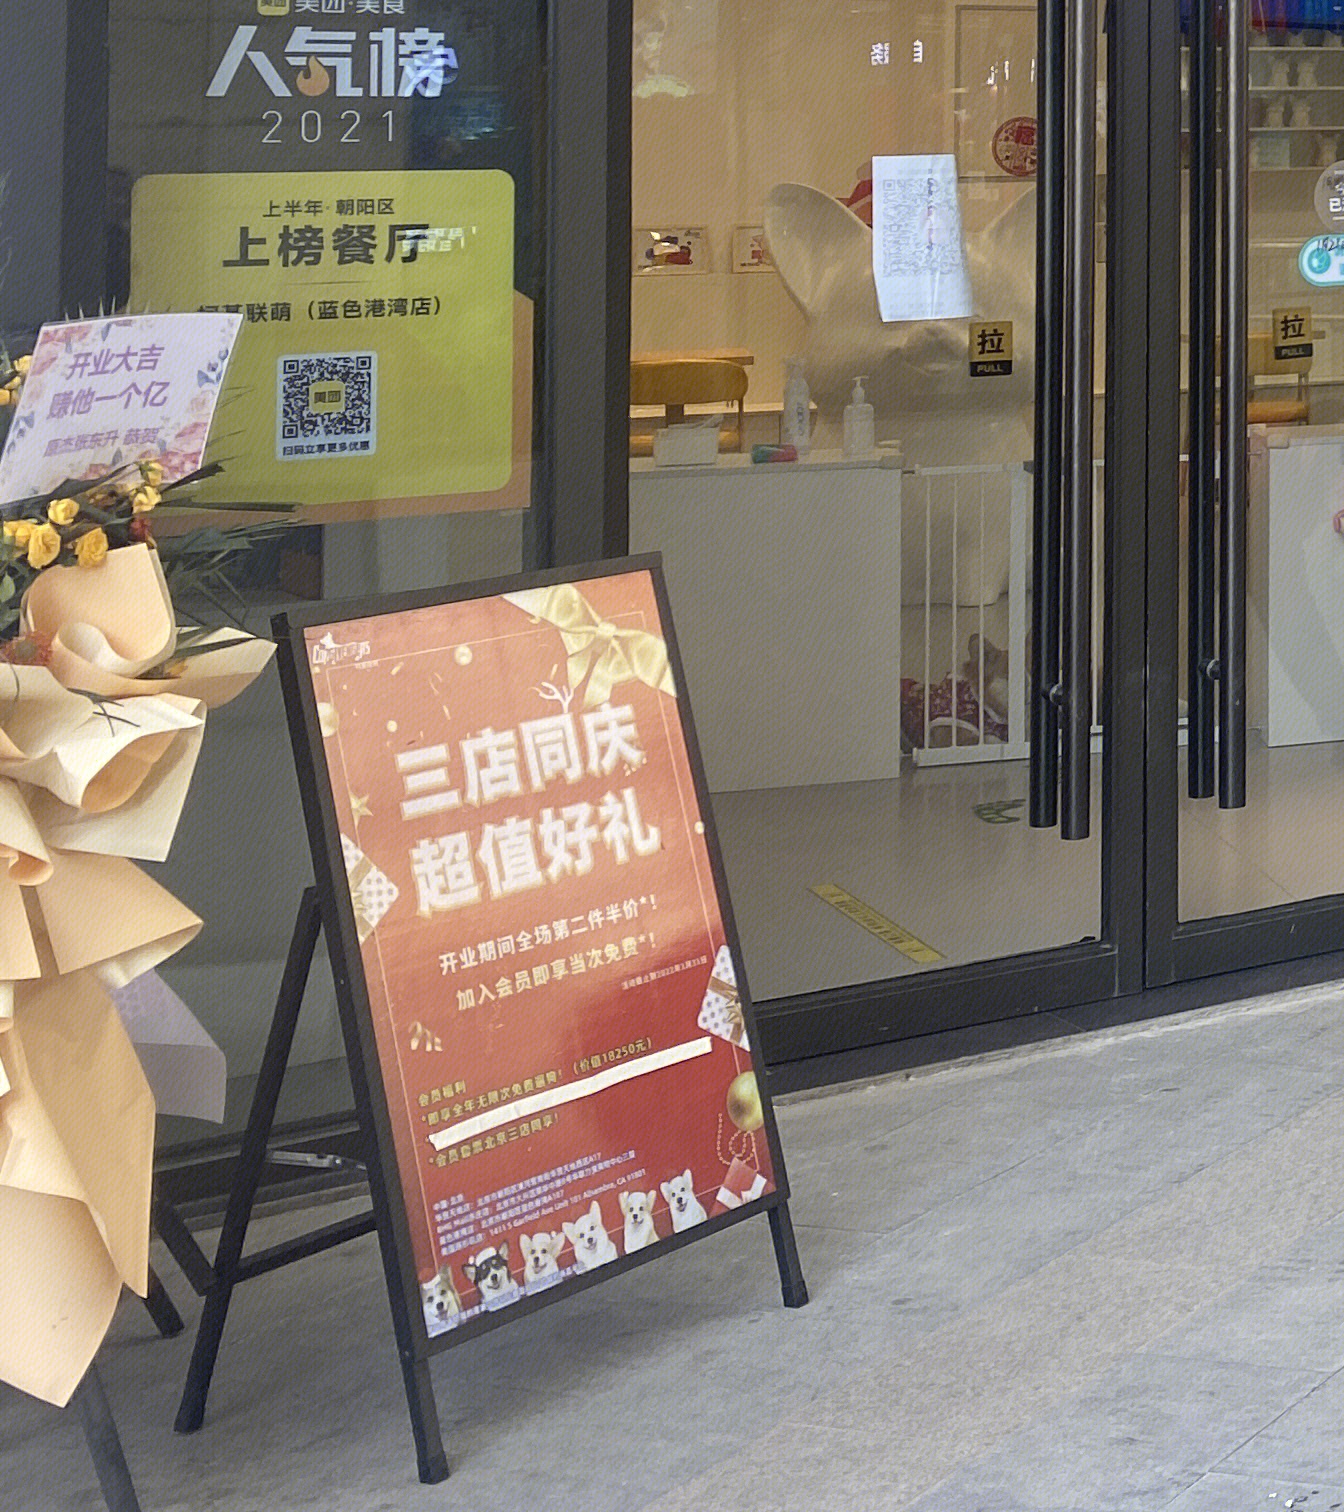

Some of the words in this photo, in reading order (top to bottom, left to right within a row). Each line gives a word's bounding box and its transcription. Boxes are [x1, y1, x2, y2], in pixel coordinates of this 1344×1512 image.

[205, 24, 446, 97] 人气榜
[261, 109, 396, 144] 2021
[222, 223, 430, 268] 上榜餐厅
[977, 329, 1005, 355] 拉
[1280, 314, 1305, 340] 拉
[66, 344, 165, 380] 开业大吉
[976, 363, 1004, 374] PULL
[47, 380, 170, 420] 赚他一个亿
[395, 701, 647, 820] 三店同庆
[409, 787, 663, 918] 超值好礼
